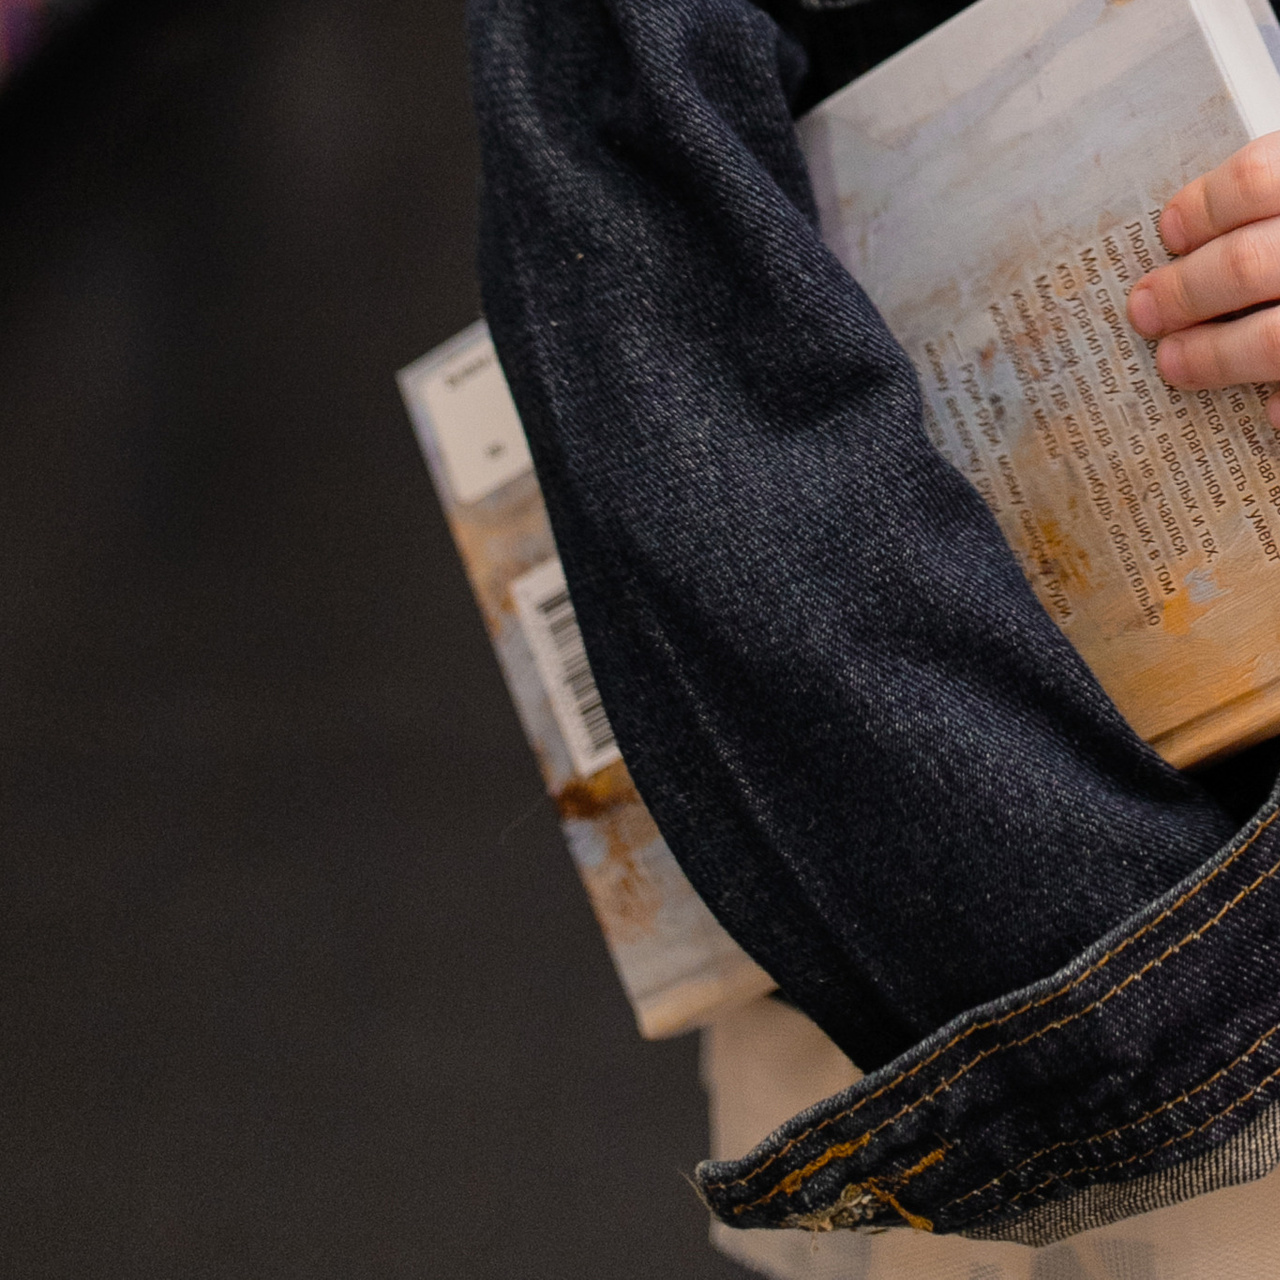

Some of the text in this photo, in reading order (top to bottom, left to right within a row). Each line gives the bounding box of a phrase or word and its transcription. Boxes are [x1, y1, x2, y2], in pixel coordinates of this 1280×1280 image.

[1055, 262, 1076, 290] кто
[1076, 247, 1103, 286] Мир
[1101, 234, 1131, 283] найти
[1064, 291, 1104, 356] утратил
[1093, 287, 1134, 361] стариков
[1094, 357, 1122, 402] веру,
[1126, 362, 1140, 375] и
[1129, 377, 1165, 432] детей,
[1174, 406, 1188, 419] в
[1008, 288, 1162, 626] измерении, где когда-нибудь обязательно
[1032, 274, 1176, 595] Мир людей, навсегда застрявших в том
[1127, 433, 1145, 456] но
[1227, 391, 1245, 413] не
[1237, 414, 1276, 483] замечая
[995, 453, 1025, 506] моему
[1137, 457, 1155, 479] не
[1154, 432, 1200, 513] взрослых
[1178, 419, 1228, 513] трагичном.
[1216, 437, 1248, 492] летать
[1146, 480, 1189, 561] отчаялся.
[1191, 514, 1205, 527] и
[1241, 493, 1256, 507] и
[1196, 528, 1219, 563] тех,
[1244, 507, 1280, 563] умеют
